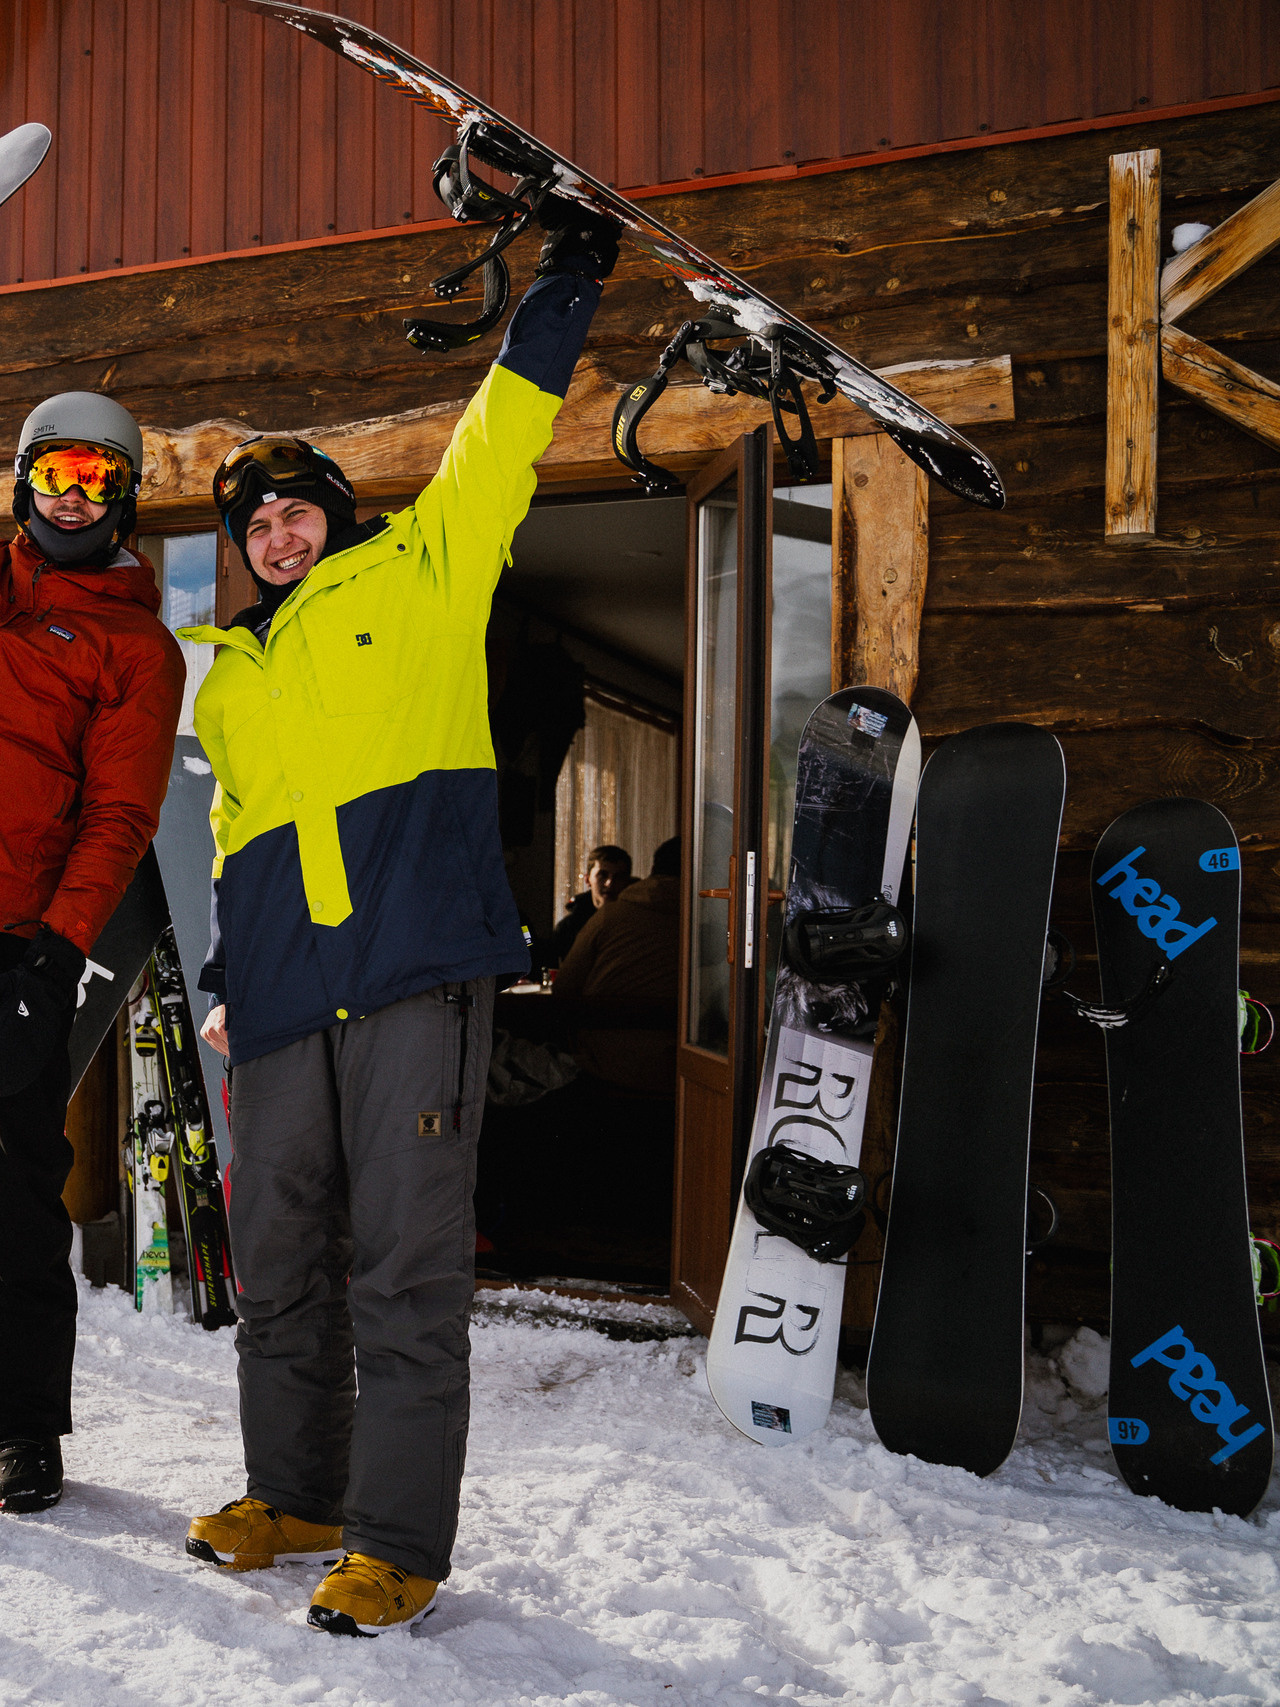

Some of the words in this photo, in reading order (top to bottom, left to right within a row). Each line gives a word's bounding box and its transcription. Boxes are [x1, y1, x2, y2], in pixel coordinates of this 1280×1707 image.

[33, 424, 56, 436] SMITH
[1207, 852, 1230, 870] 46
[1096, 845, 1218, 961] head
[201, 1241, 217, 1308] SUPERSHAPE
[1130, 1324, 1266, 1466] head
[1118, 1420, 1141, 1441] 46
